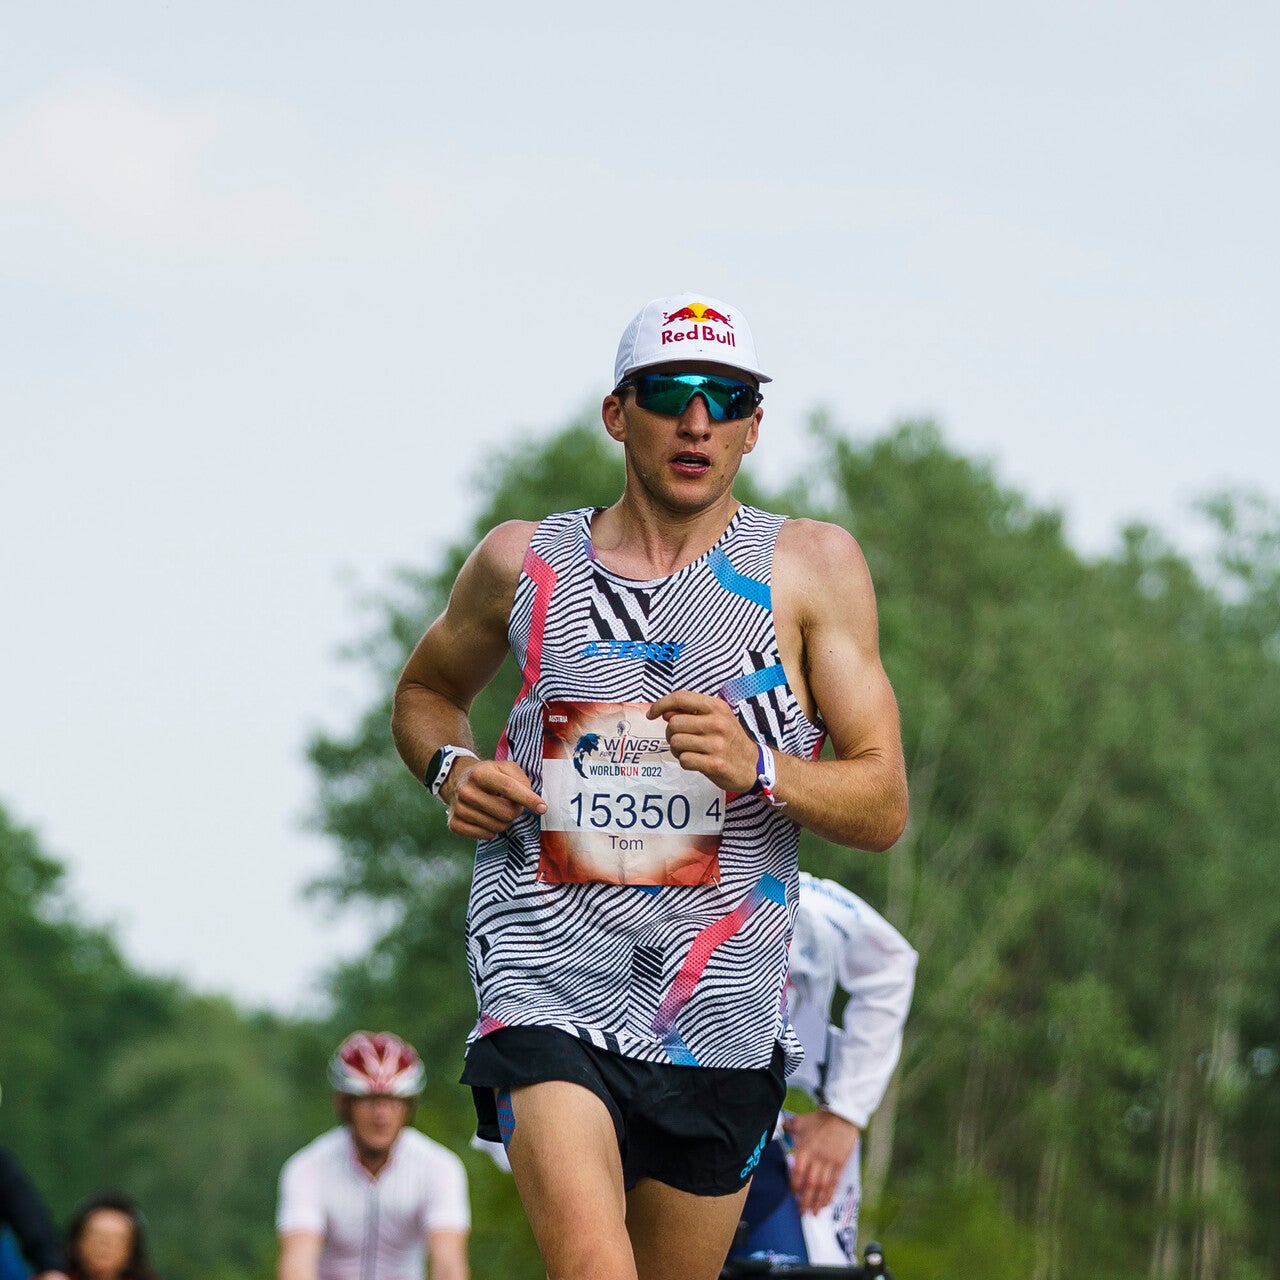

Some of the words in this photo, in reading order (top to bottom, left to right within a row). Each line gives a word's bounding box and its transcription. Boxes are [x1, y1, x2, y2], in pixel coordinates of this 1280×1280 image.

[662, 324, 699, 345] Red
[702, 326, 736, 347] Bull
[608, 639, 686, 660] TERREX
[603, 737, 660, 752] WINGS
[610, 752, 643, 764] LIFE
[641, 766, 662, 777] 2022
[570, 792, 690, 829] 15350
[705, 797, 721, 822] 4
[608, 835, 643, 850] Tom
